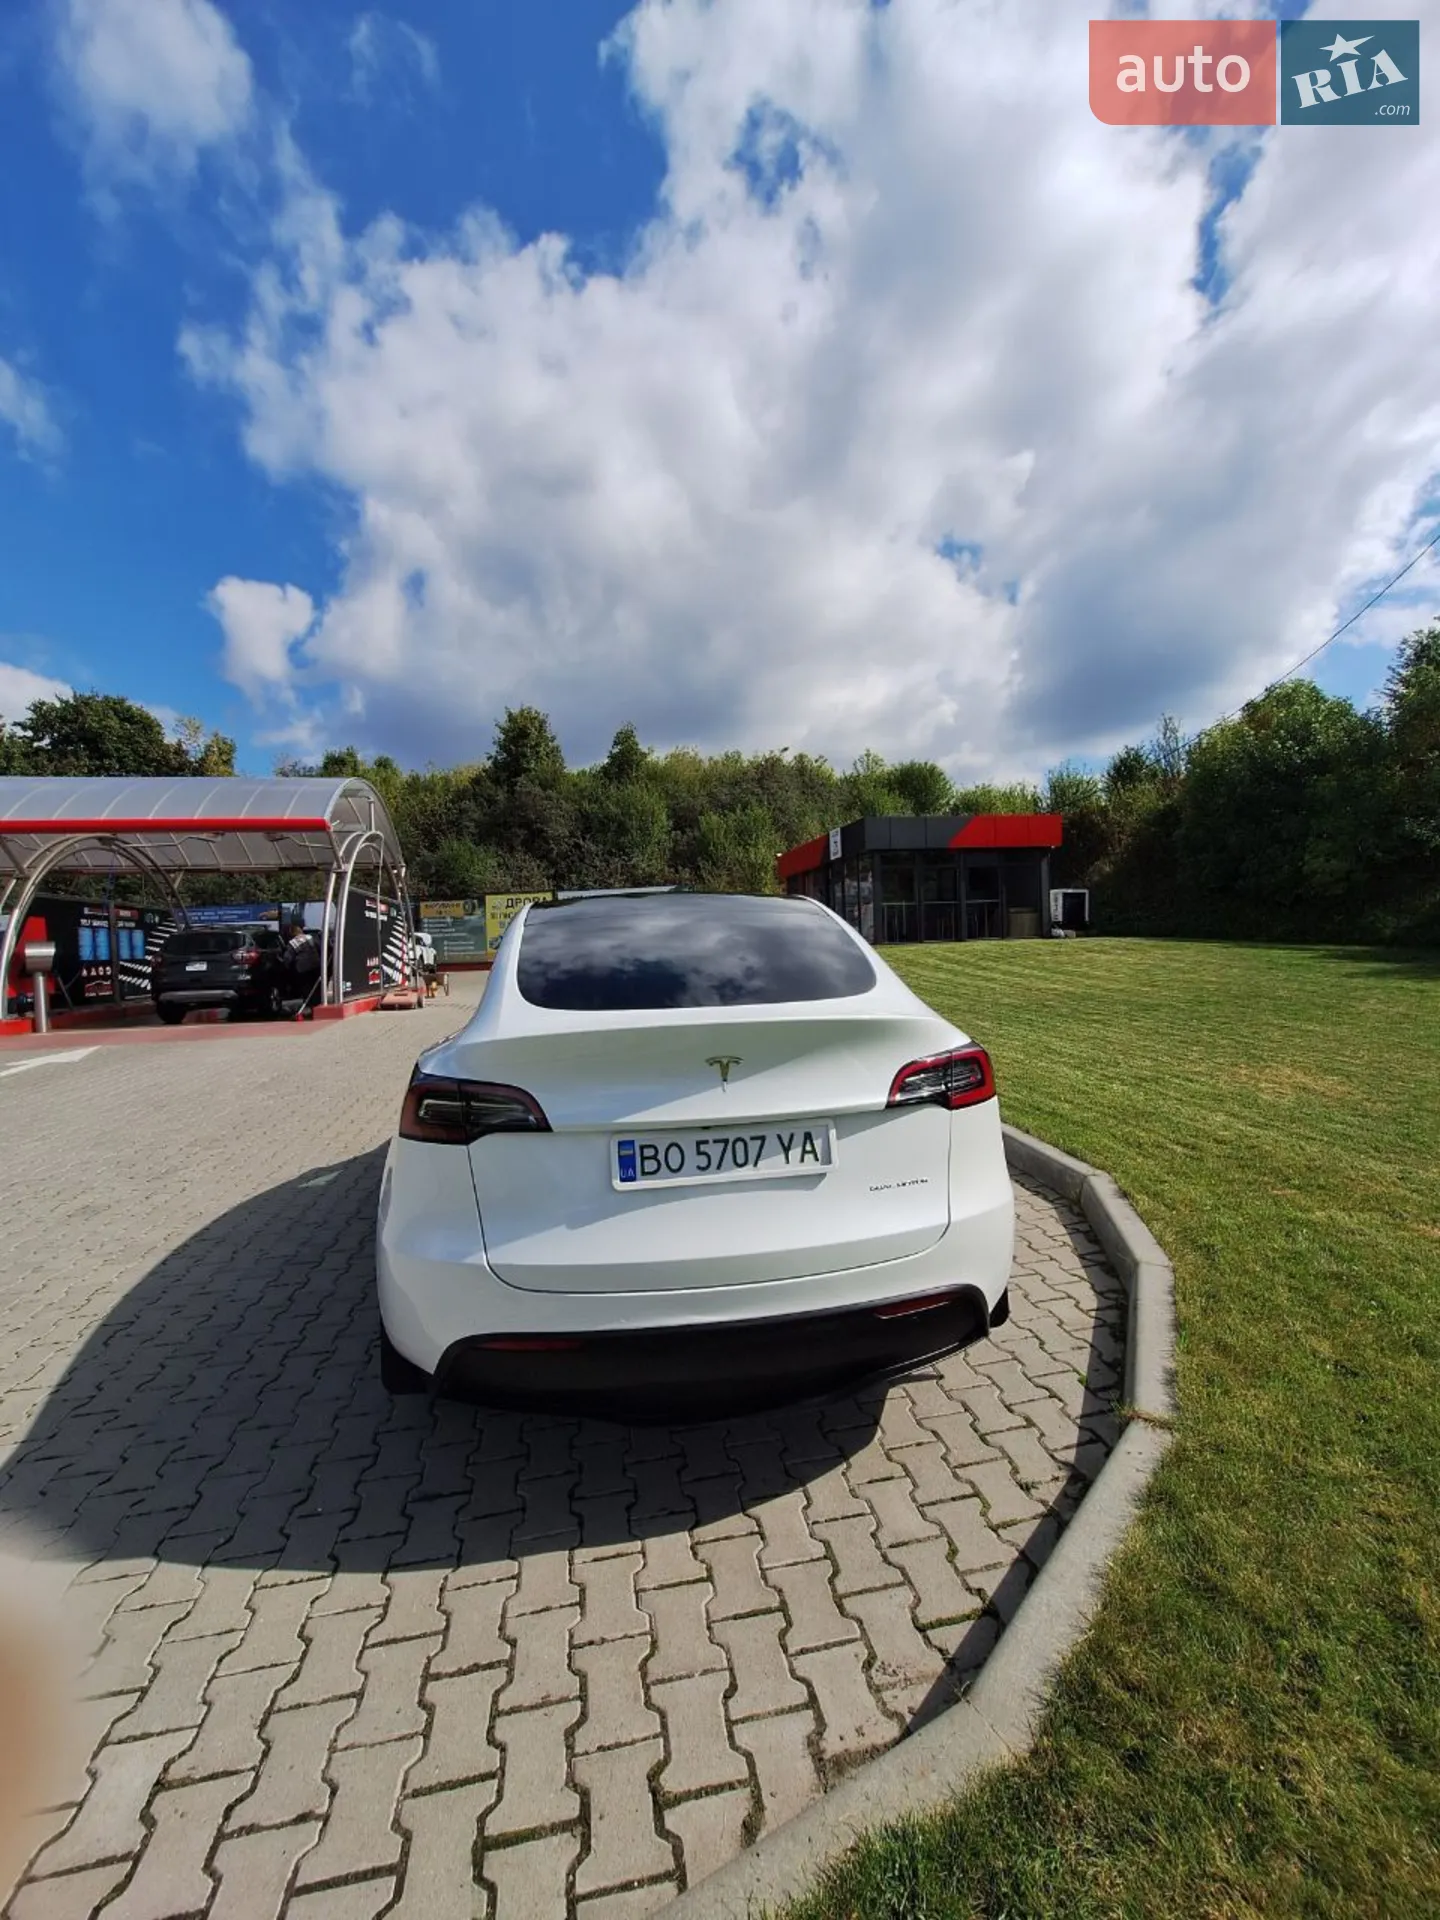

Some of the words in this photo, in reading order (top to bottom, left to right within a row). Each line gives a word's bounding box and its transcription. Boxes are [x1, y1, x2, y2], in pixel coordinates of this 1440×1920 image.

[638, 1142, 686, 1177] BO
[695, 1134, 767, 1172] 5707
[776, 1131, 820, 1165] YA
[619, 1168, 636, 1179] UA
